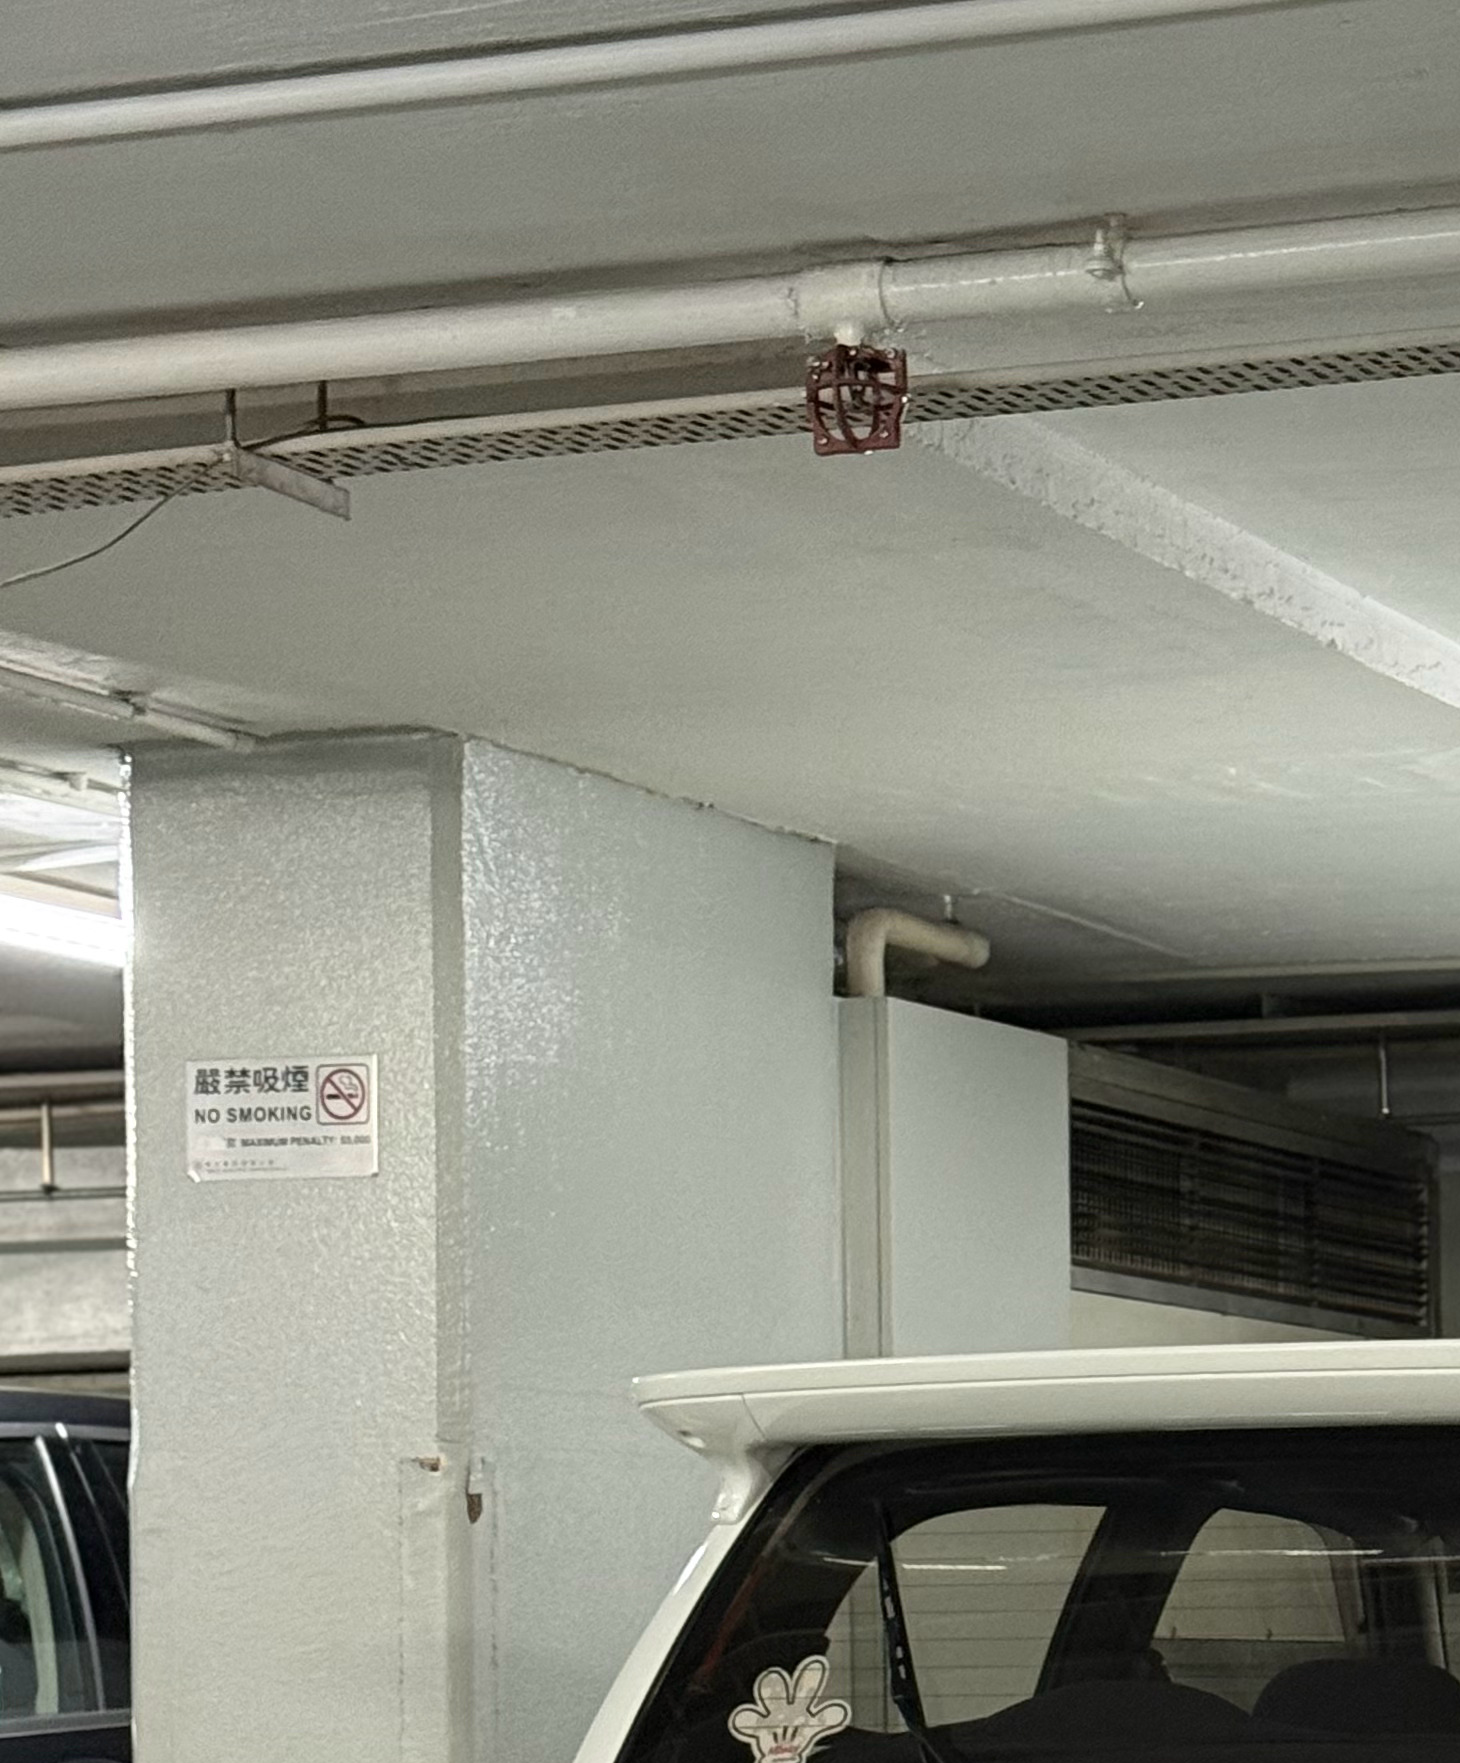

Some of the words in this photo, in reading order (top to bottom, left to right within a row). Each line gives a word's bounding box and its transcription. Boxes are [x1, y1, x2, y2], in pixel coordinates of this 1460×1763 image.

[194, 1064, 309, 1095] 嚴禁吸煙
[194, 1108, 221, 1124] NO
[226, 1105, 312, 1124] SMOKING
